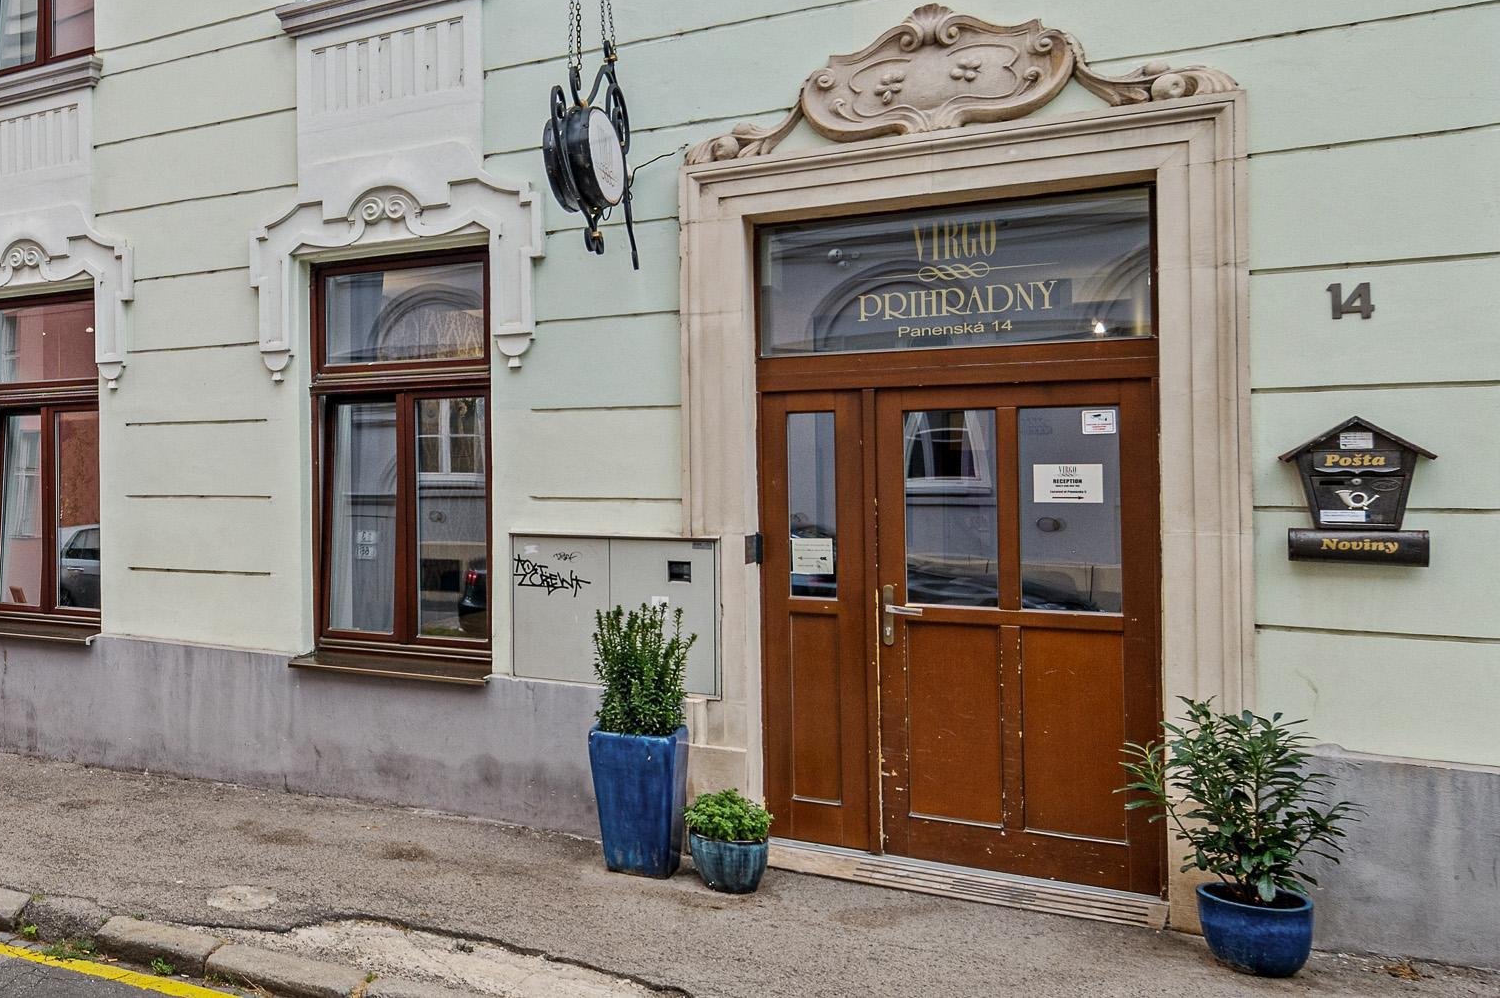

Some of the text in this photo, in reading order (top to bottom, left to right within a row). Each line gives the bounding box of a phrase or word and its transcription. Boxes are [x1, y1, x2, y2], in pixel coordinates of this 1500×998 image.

[912, 219, 997, 262] VIRGO
[857, 281, 1058, 322] PRIHRADNY
[1326, 282, 1376, 320] 14
[898, 320, 1013, 338] Panenská 14
[1324, 453, 1387, 467] Pošta
[1320, 538, 1399, 554] Noviny
